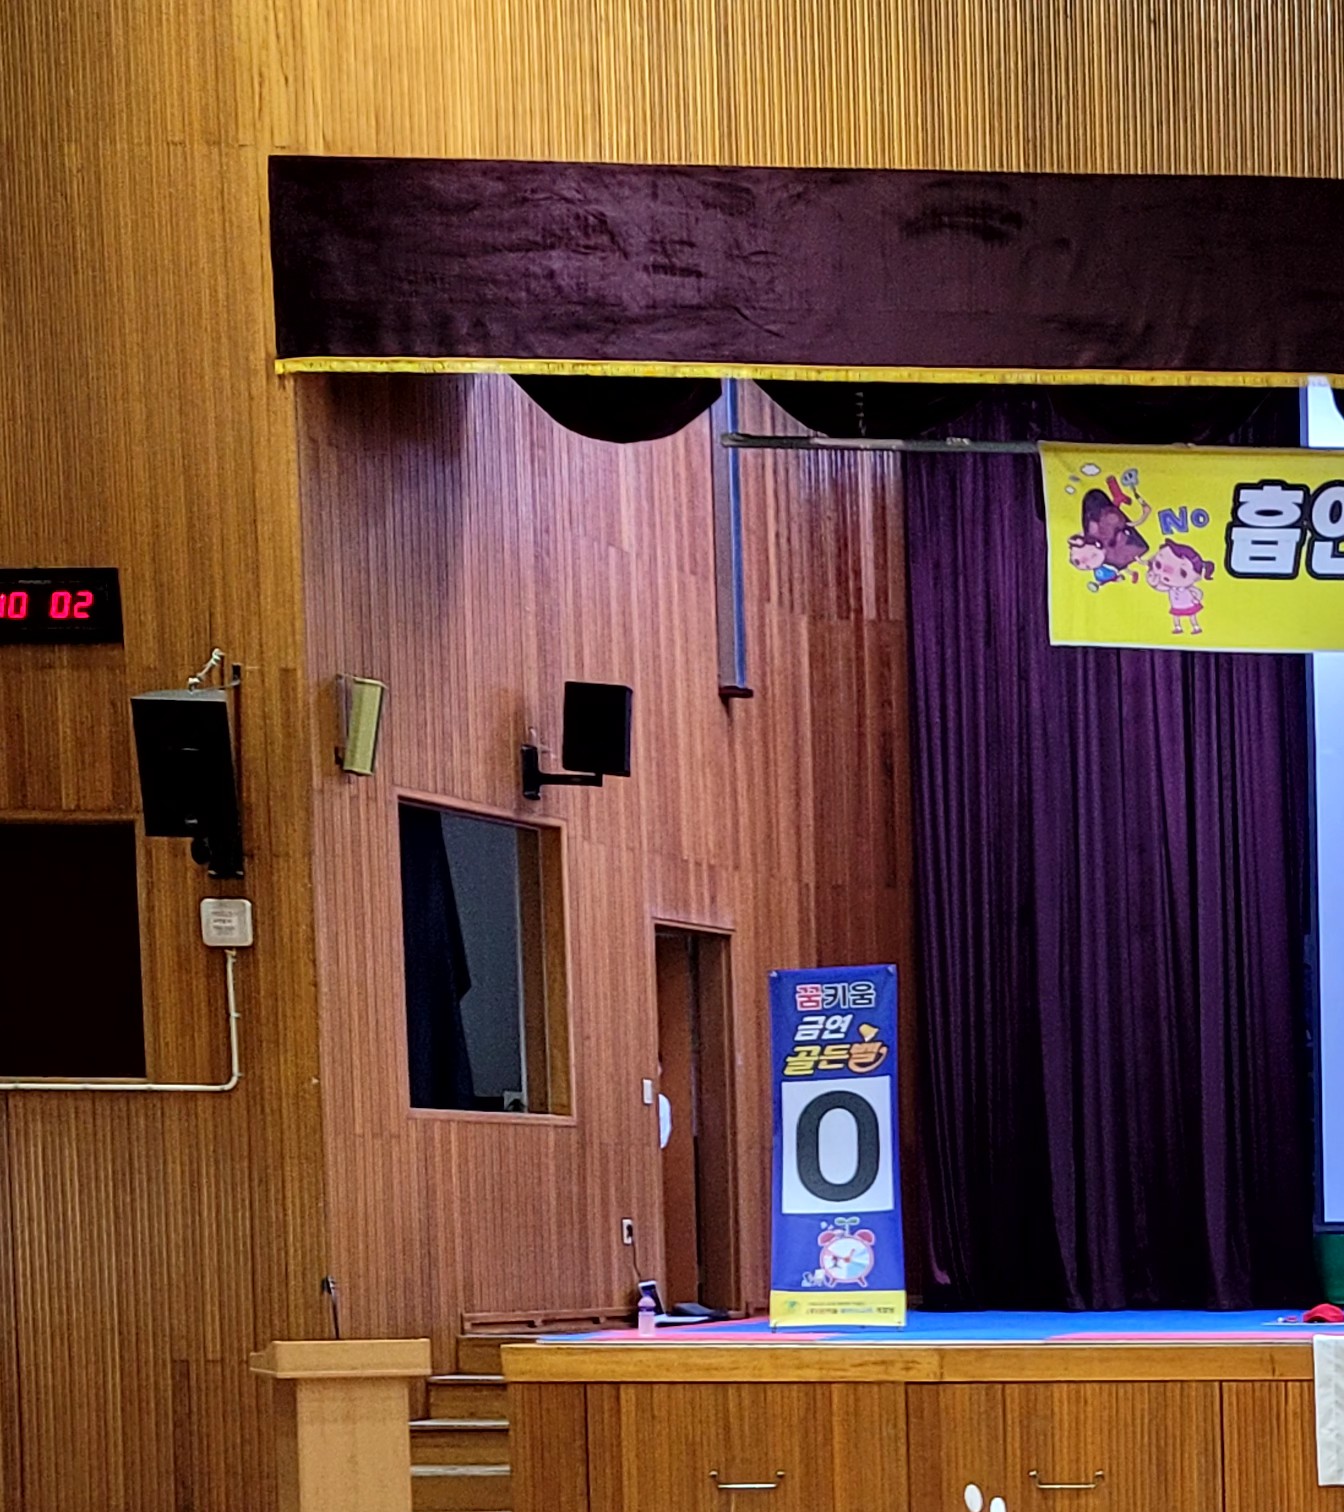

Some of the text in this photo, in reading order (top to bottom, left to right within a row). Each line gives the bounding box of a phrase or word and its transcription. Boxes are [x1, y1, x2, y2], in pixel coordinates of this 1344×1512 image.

[50, 591, 94, 618] 02
[795, 980, 877, 1012] 꿈키움
[794, 1013, 853, 1043] 금연
[782, 1041, 888, 1077] 골든벨
